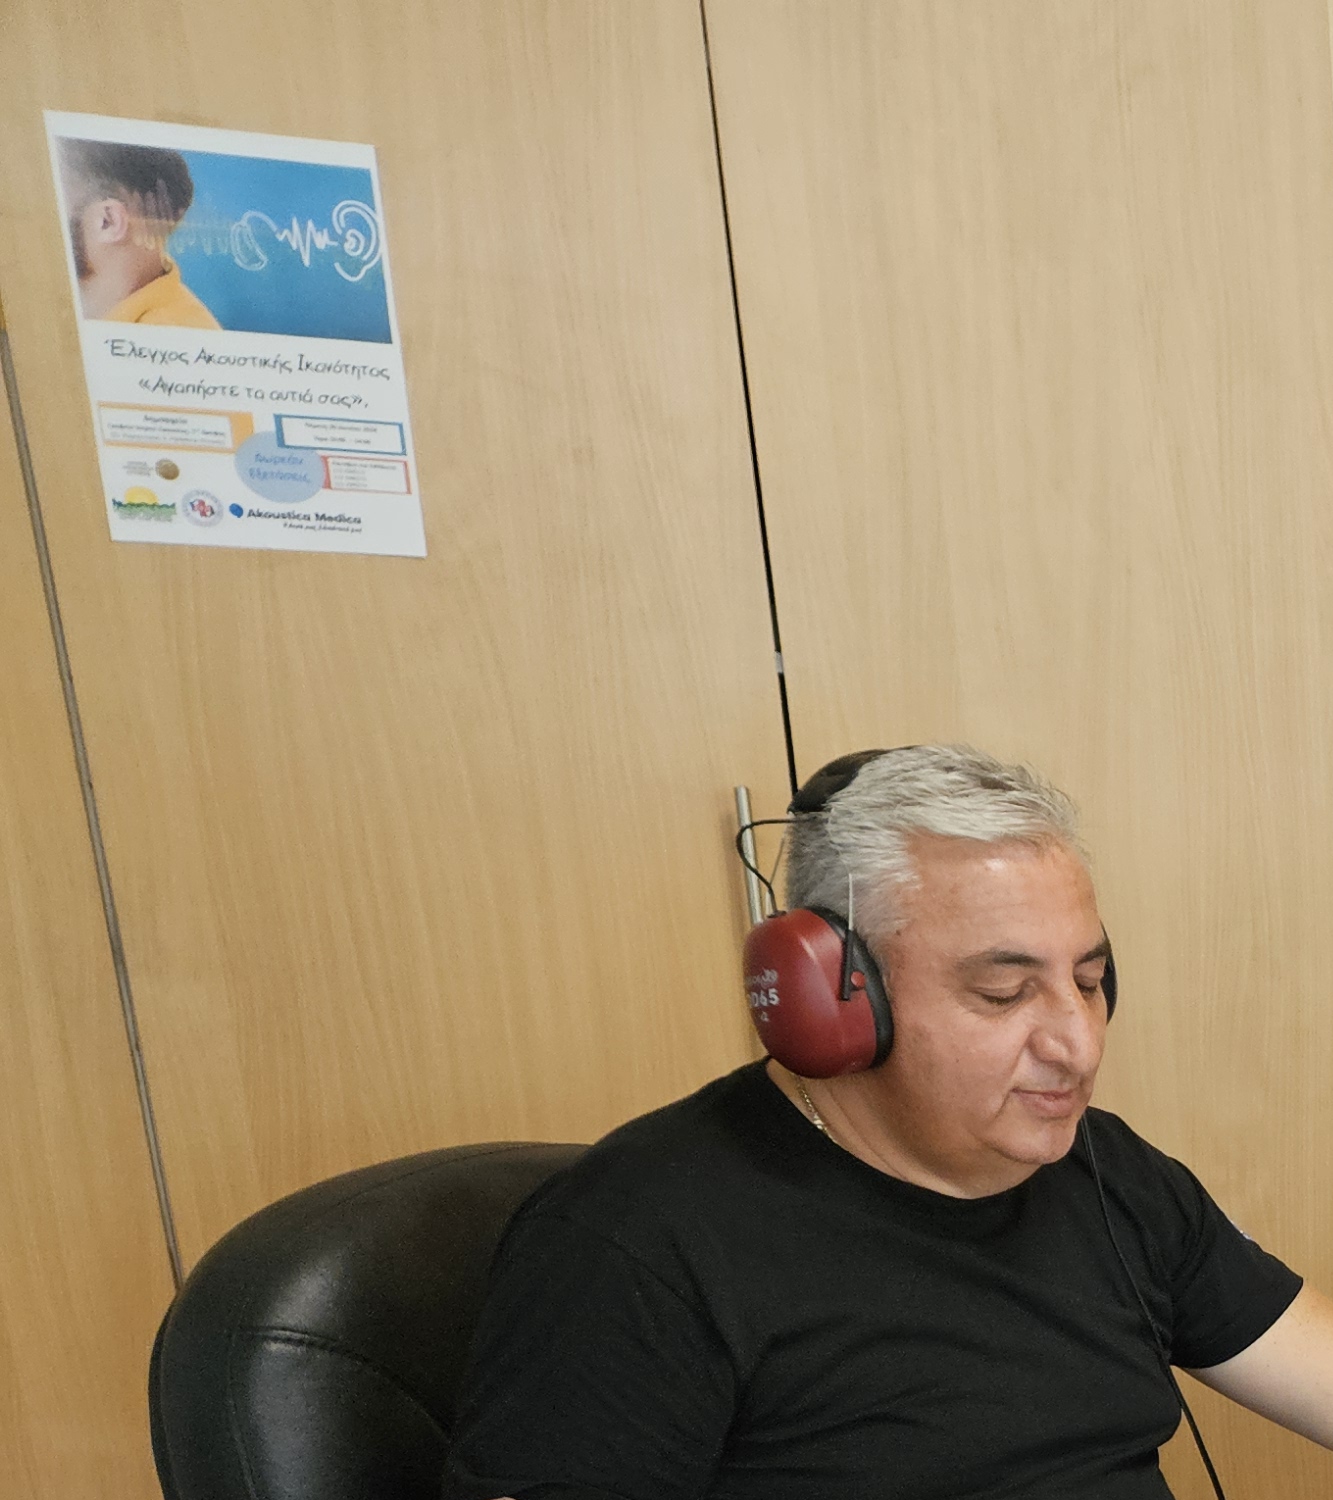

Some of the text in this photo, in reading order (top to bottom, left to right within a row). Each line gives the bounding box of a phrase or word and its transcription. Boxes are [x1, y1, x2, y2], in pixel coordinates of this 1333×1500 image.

[104, 338, 391, 381] Έλεγχος Ακουστικής Ικανότητας
[139, 376, 240, 400] «Αγαπήστε
[246, 387, 265, 399] τα
[269, 387, 314, 405] αυτιά
